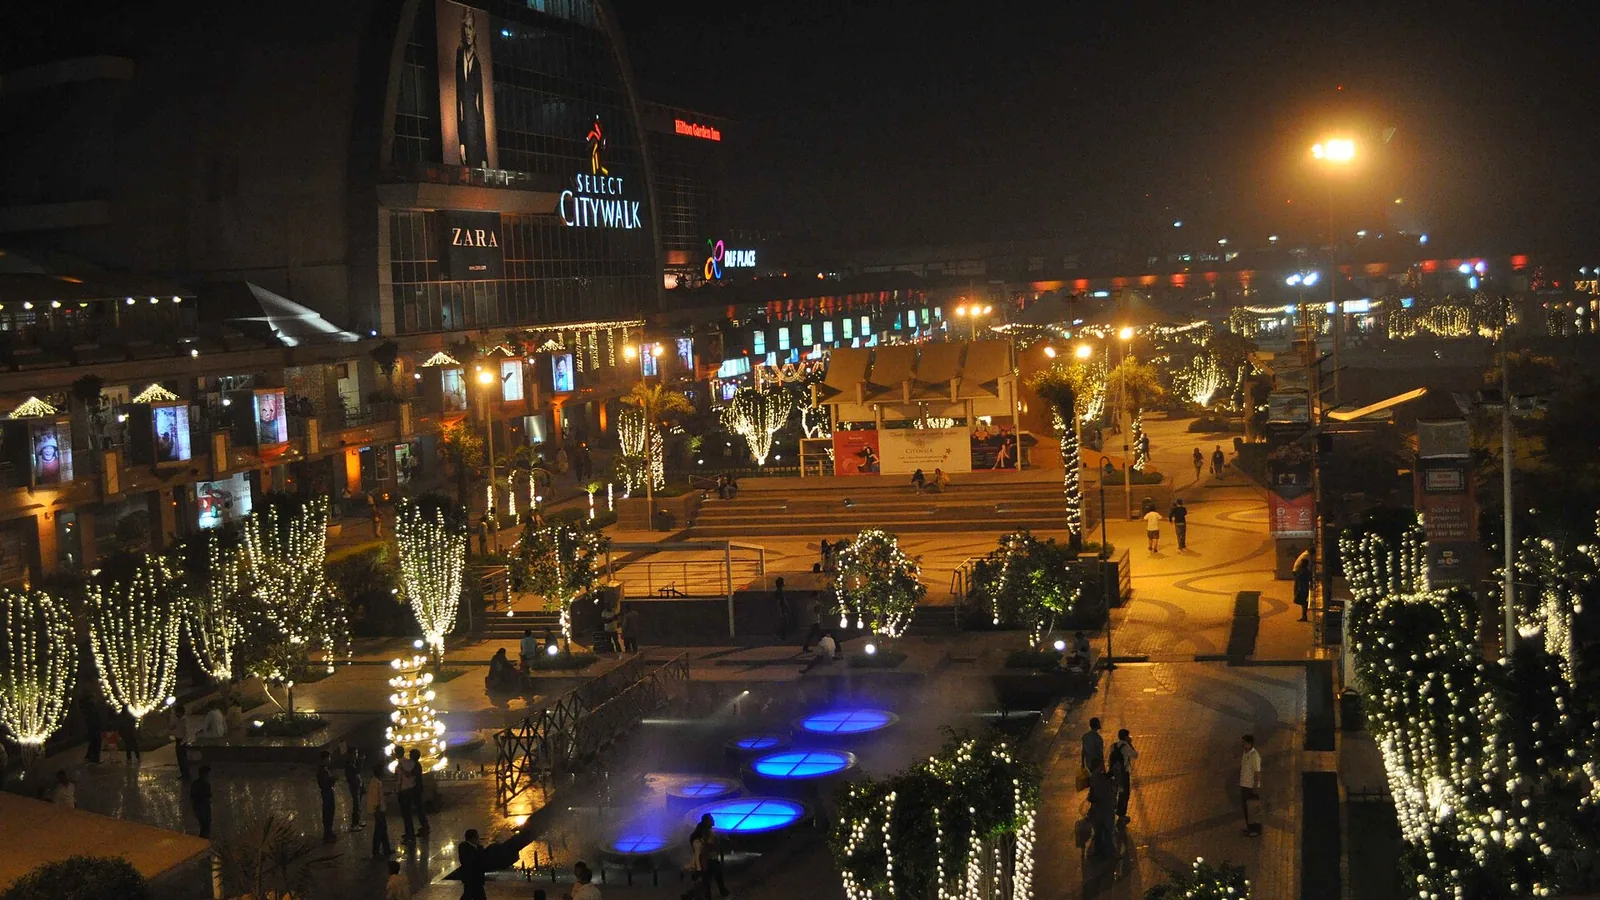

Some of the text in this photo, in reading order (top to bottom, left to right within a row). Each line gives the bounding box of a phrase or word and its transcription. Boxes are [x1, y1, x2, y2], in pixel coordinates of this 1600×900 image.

[674, 118, 721, 142] Hilton Garden Inn
[577, 173, 623, 195] SELECT
[560, 189, 642, 229] CITYWALK
[451, 227, 499, 248] ZARA
[724, 249, 756, 267] DLF PLACE
